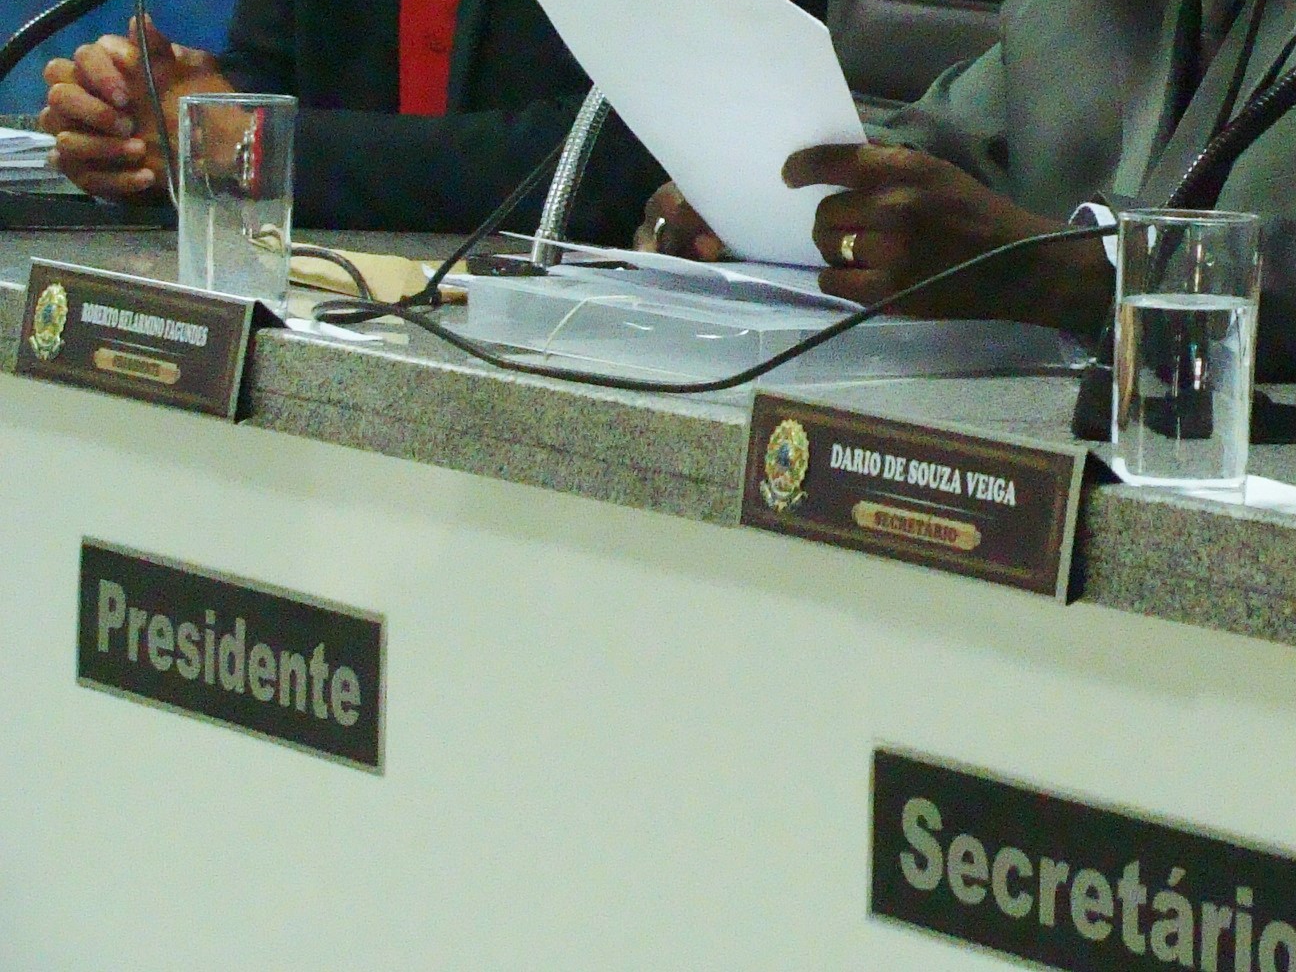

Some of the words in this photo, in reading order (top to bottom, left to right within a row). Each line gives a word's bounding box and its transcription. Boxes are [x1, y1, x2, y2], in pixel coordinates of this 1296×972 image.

[80, 302, 119, 328] ROBERTO
[830, 442, 882, 478] DARIO
[883, 453, 906, 482] DE
[907, 459, 962, 496] SOUZA
[966, 470, 1017, 507] VEIGA
[97, 578, 362, 727] Presidente
